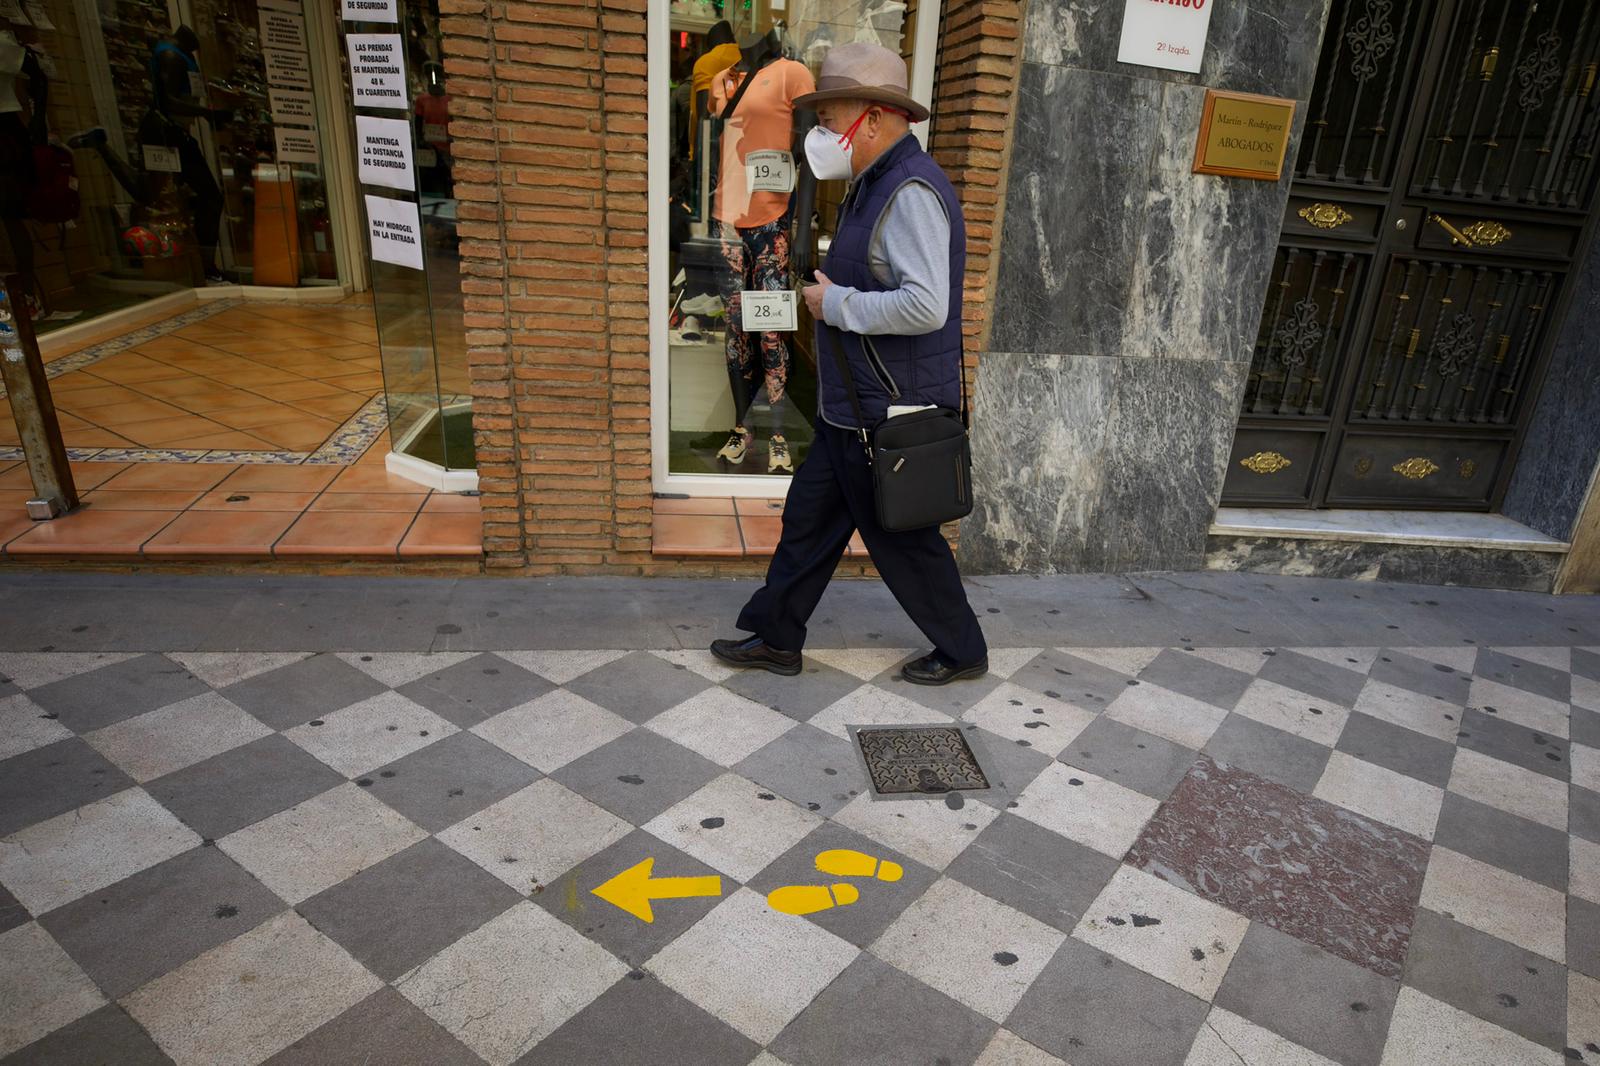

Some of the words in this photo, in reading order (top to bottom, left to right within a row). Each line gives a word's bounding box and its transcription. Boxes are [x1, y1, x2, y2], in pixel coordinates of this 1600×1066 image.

[357, 2, 388, 10] SEGURIDAD
[368, 44, 393, 52] PRENDAS
[360, 55, 389, 63] PROBADAS
[361, 65, 400, 74] MANTENDRÁN
[365, 88, 401, 97] CUARENTENA
[366, 136, 400, 146] MANTENGA
[1217, 136, 1274, 152] ABOGADOS
[373, 147, 404, 158] DISTANCIA
[363, 158, 371, 166] DE
[373, 159, 406, 170] SEGURIDAD
[373, 220, 385, 228] HAY
[386, 222, 412, 233] HIDROGEL
[373, 229, 381, 237] EN
[382, 231, 389, 239] LA
[390, 232, 415, 244] ENTRADA
